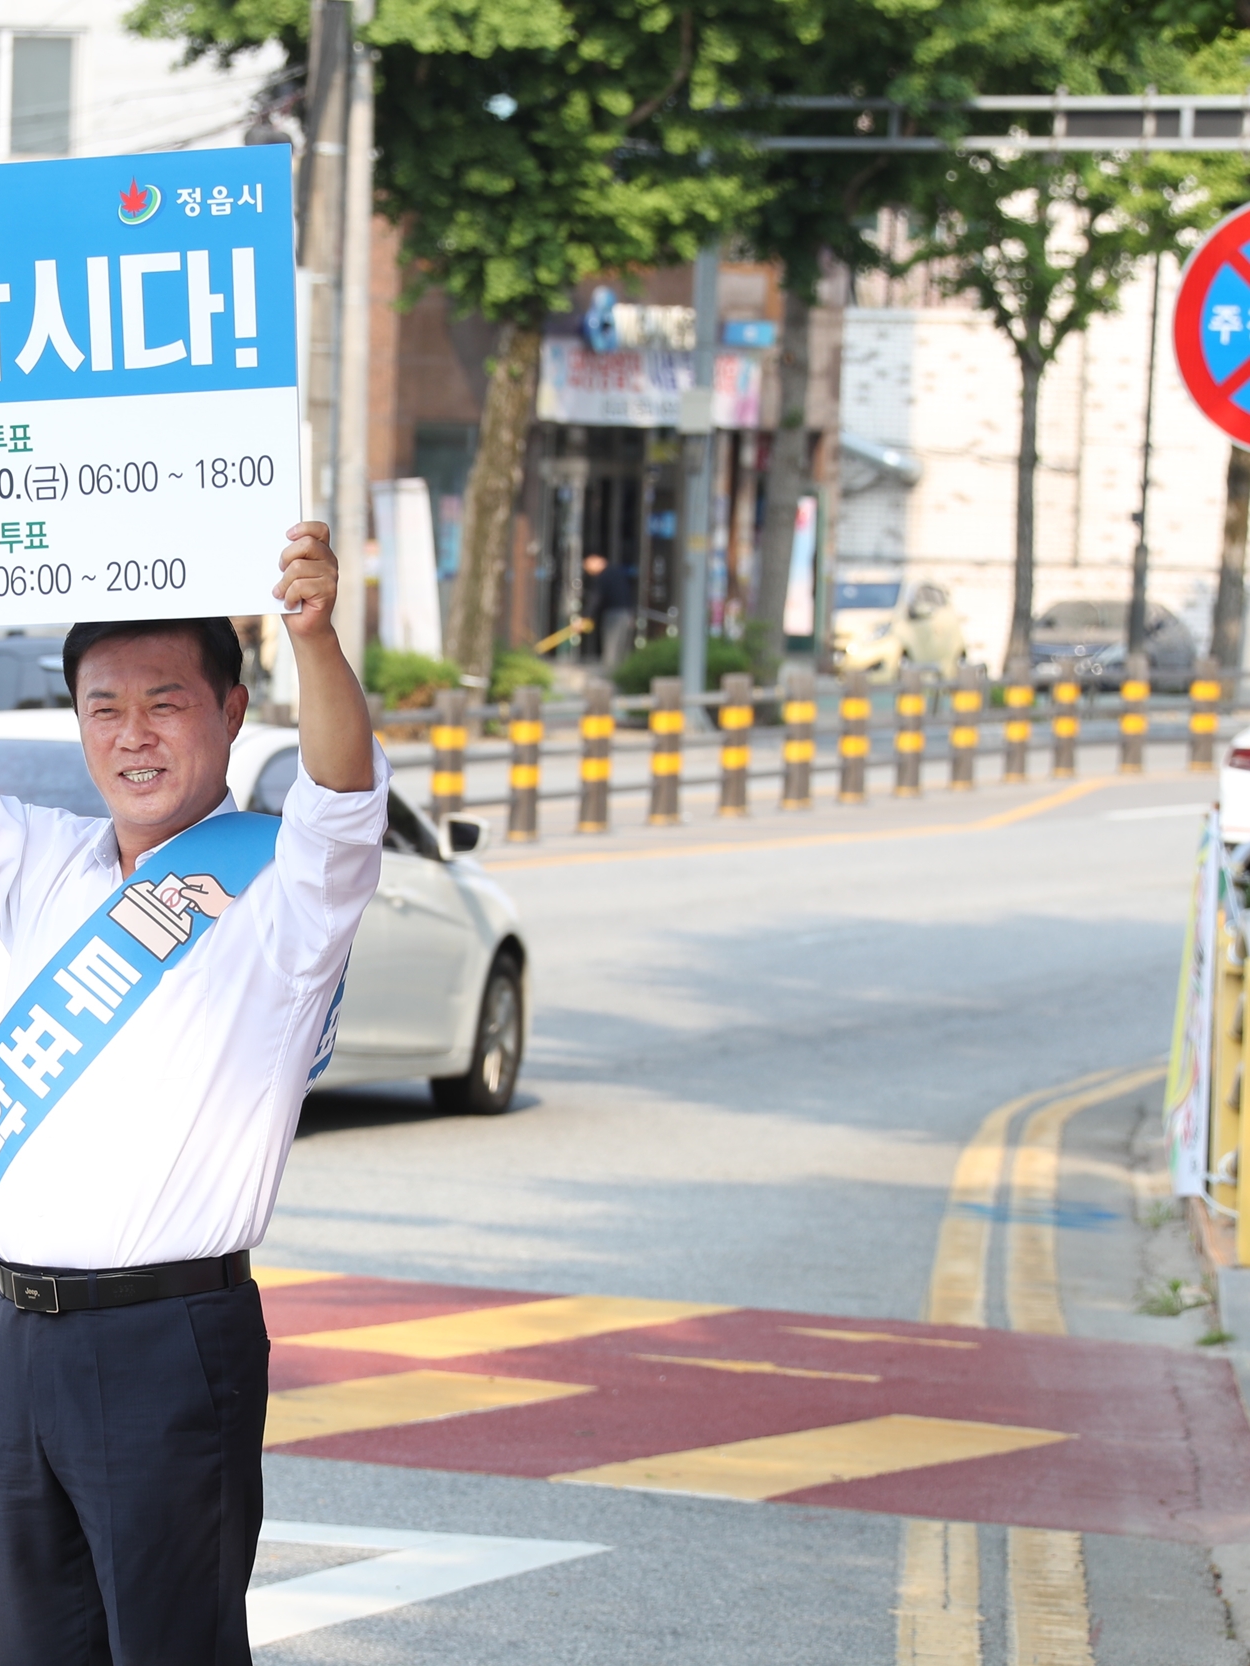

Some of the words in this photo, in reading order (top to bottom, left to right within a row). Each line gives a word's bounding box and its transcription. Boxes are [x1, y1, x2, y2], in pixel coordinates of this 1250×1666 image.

[176, 182, 263, 217] 정읍시
[1208, 304, 1250, 345] 주
[78, 461, 158, 495] 06:00
[195, 455, 274, 489] 18:00
[106, 558, 186, 592] 20:00
